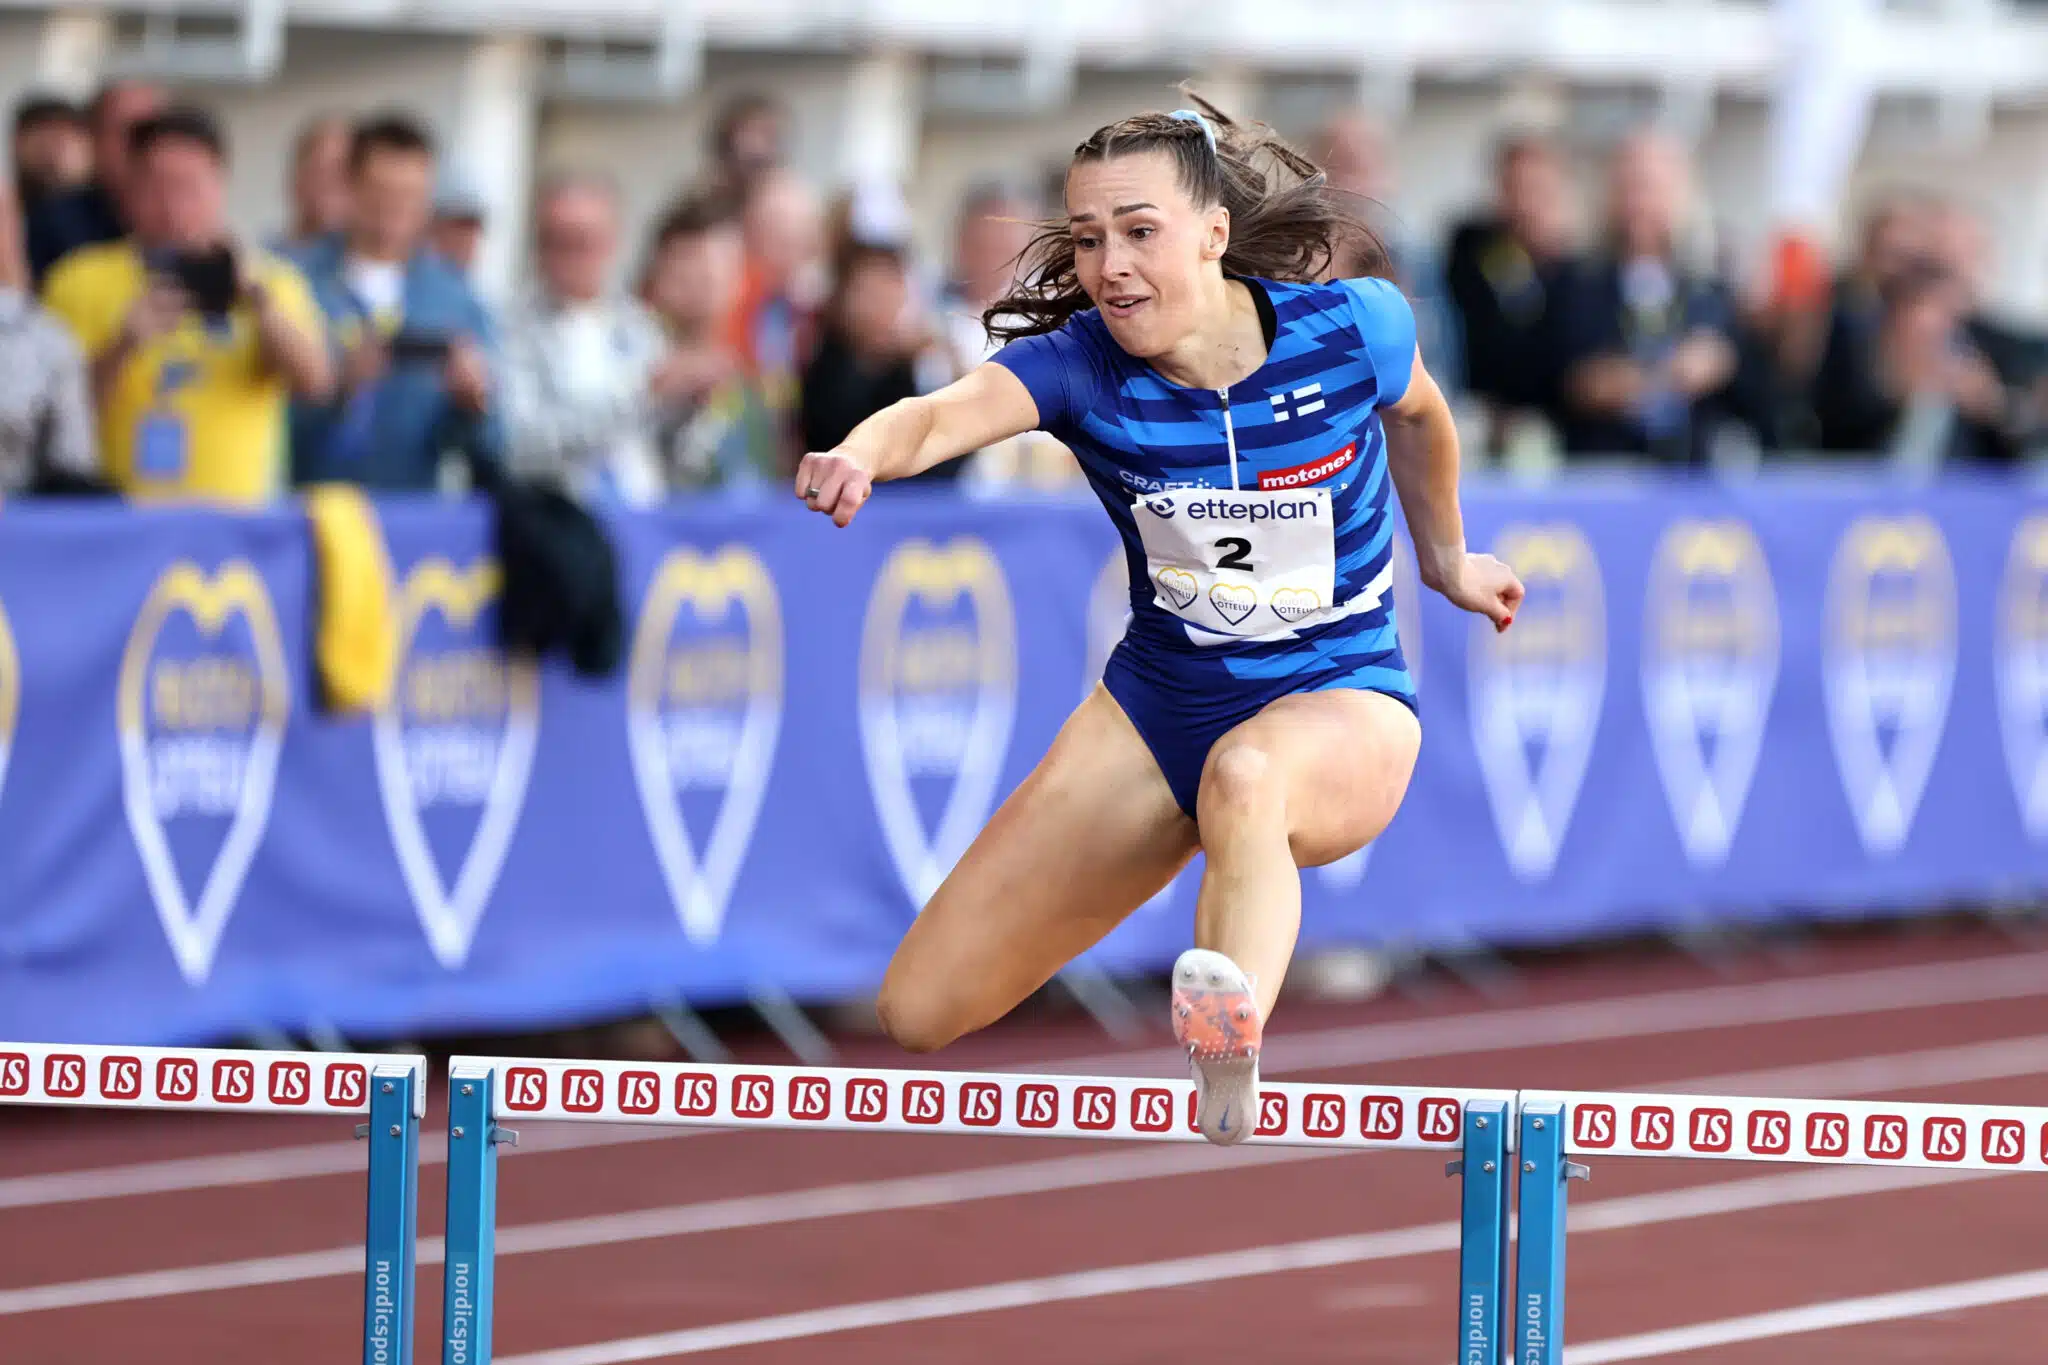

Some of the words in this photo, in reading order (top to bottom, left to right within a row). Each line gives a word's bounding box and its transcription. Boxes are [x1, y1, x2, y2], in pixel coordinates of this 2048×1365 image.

[1263, 448, 1353, 488] motonet
[1187, 499, 1318, 523] etteplan
[1214, 537, 1254, 572] 2
[48, 1060, 81, 1092] IS
[105, 1061, 137, 1094] IS
[161, 1063, 193, 1096] IS
[217, 1065, 249, 1097] IS
[273, 1067, 306, 1099] IS
[329, 1069, 362, 1101] IS
[510, 1073, 542, 1105] IS
[566, 1075, 599, 1107] IS
[623, 1077, 655, 1109] IS
[679, 1078, 712, 1111] IS
[736, 1080, 769, 1113] IS
[793, 1082, 826, 1114] IS
[850, 1084, 883, 1116] IS
[907, 1086, 940, 1118] IS
[964, 1088, 997, 1120] IS
[1021, 1090, 1054, 1122] IS
[1078, 1092, 1111, 1124] IS
[1135, 1094, 1168, 1126] IS
[1307, 1099, 1341, 1132] IS
[1365, 1101, 1398, 1134] IS
[1423, 1103, 1456, 1136] IS
[1577, 1109, 1611, 1142] IS
[1636, 1111, 1669, 1144] IS
[1694, 1113, 1728, 1146] IS
[1752, 1115, 1786, 1149] IS
[1810, 1118, 1844, 1151] IS
[1869, 1120, 1903, 1153] IS
[1928, 1123, 1962, 1156] IS
[1986, 1125, 2020, 1158] IS
[370, 1261, 394, 1365] nordicspo
